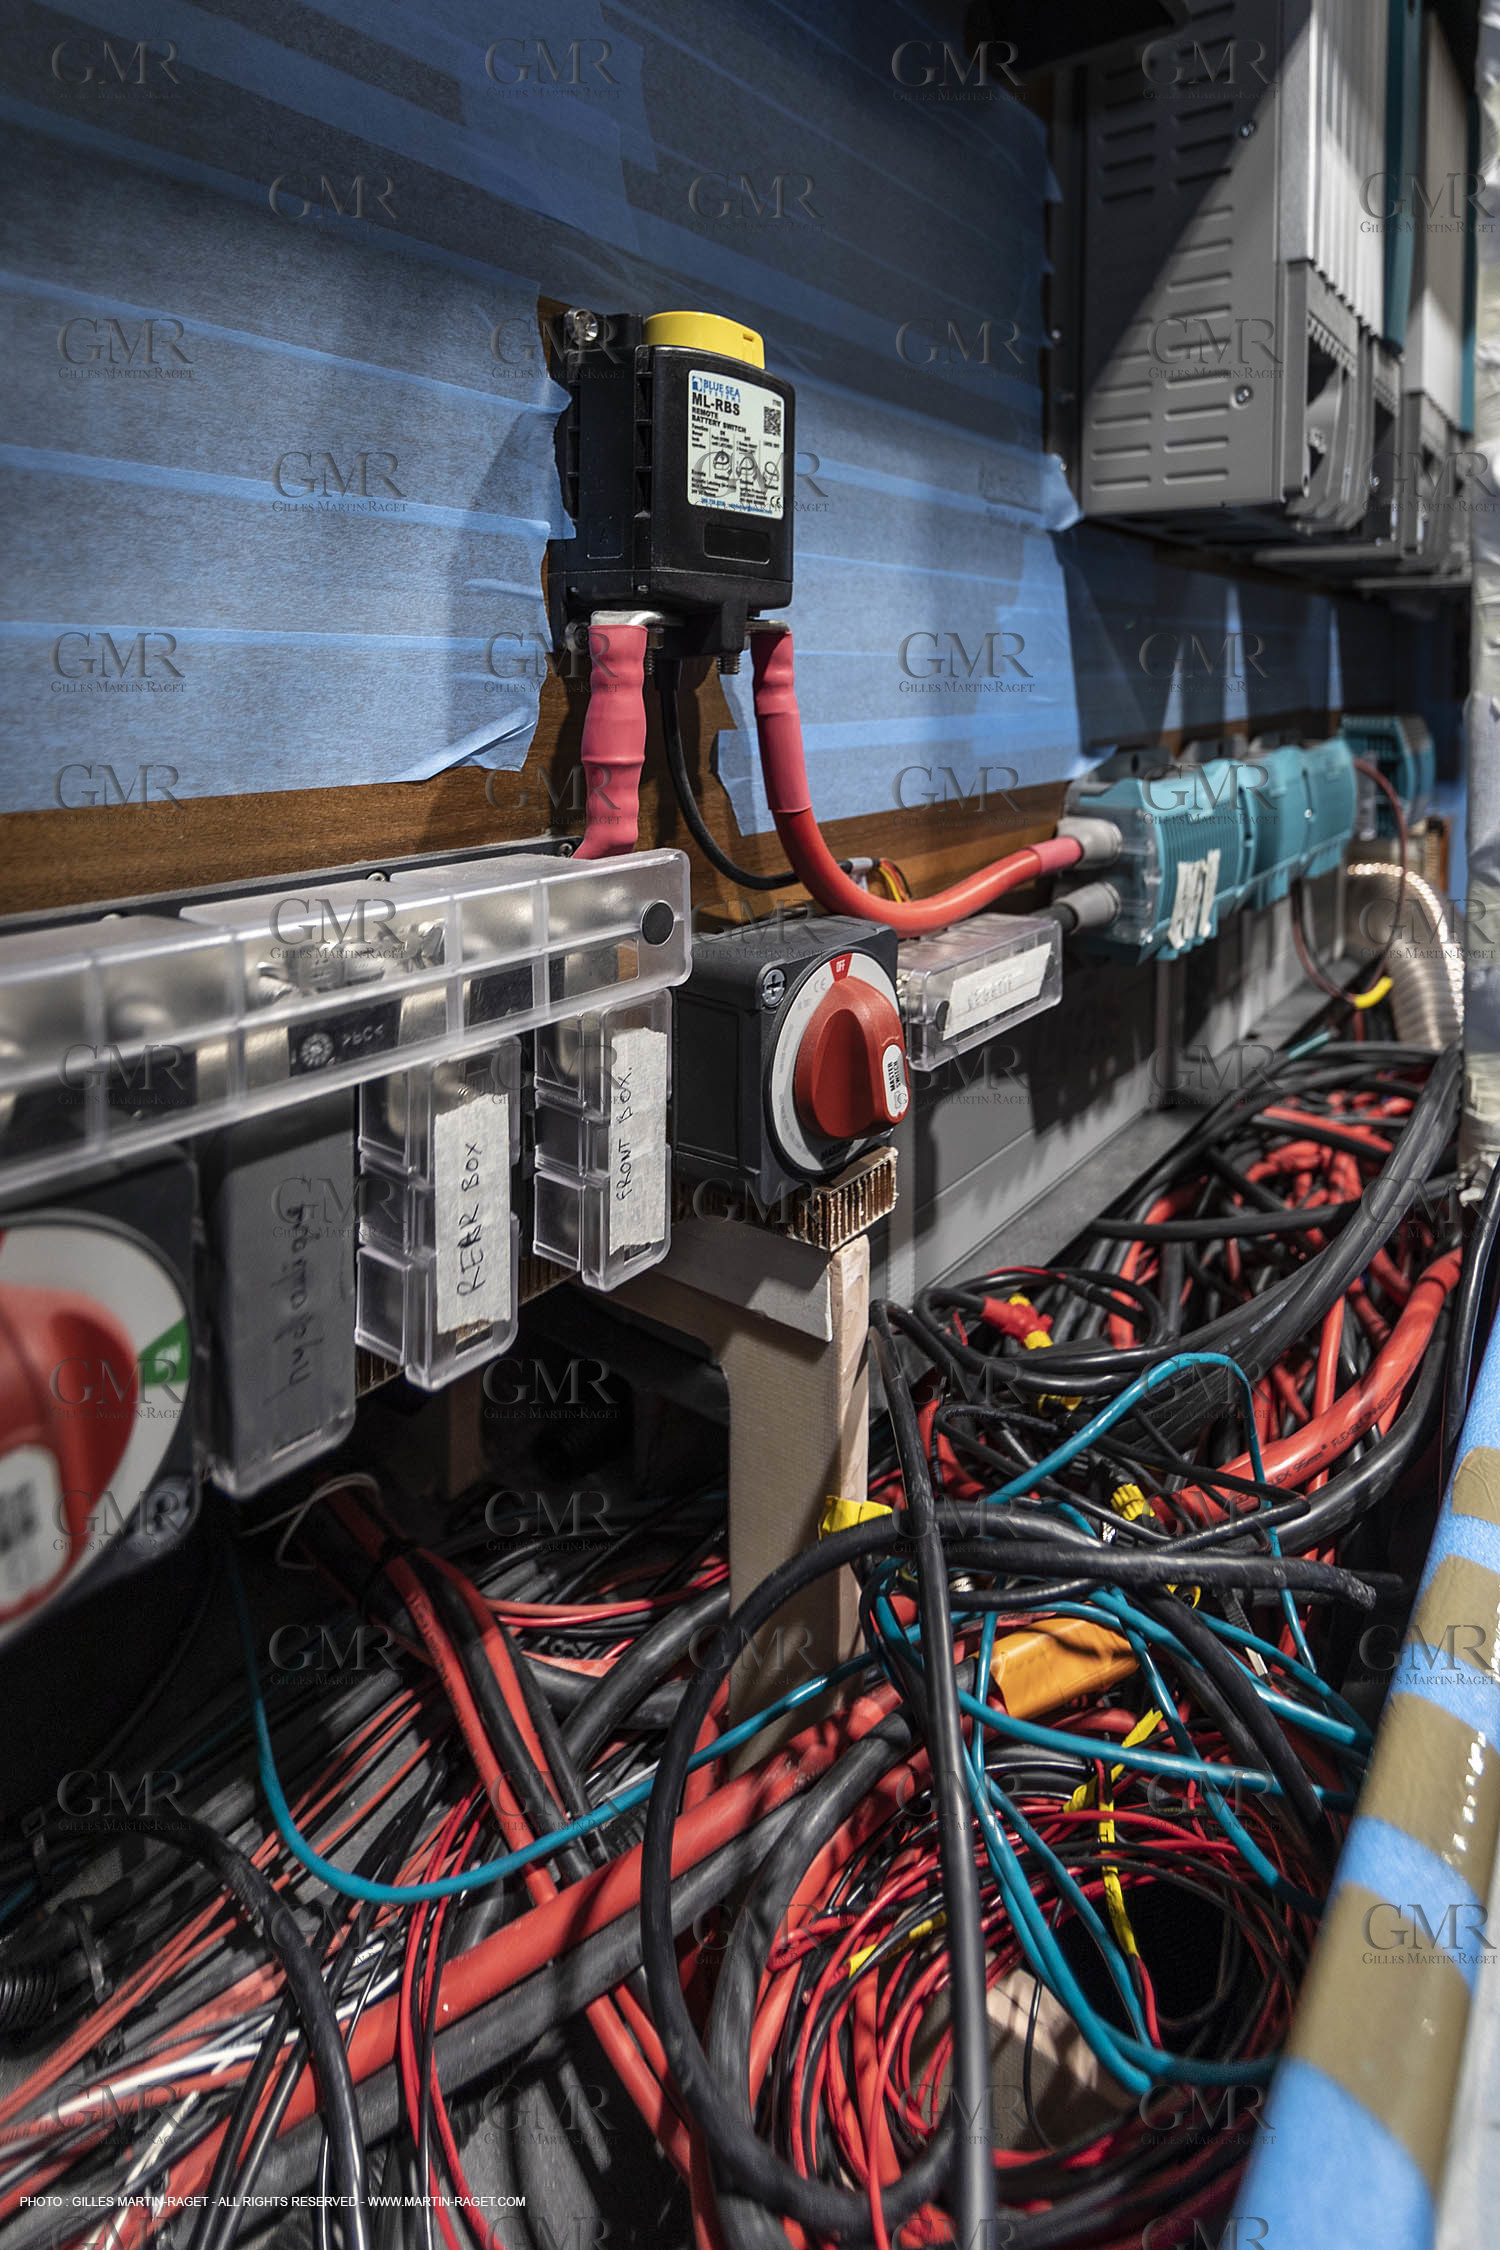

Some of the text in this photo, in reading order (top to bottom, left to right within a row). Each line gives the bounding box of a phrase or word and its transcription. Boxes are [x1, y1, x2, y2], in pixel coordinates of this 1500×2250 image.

[703, 379, 739, 397] BLUE SEA
[692, 392, 740, 416] ML-RBS
[692, 407, 718, 419] REMOTE
[692, 415, 746, 433] BATTERY SWITCH
[835, 959, 846, 973] OFF
[887, 1061, 896, 1092] MASTER
[893, 1060, 901, 1089] SWITCH
[461, 1142, 482, 1193] BOX
[615, 1138, 633, 1201] FRONT
